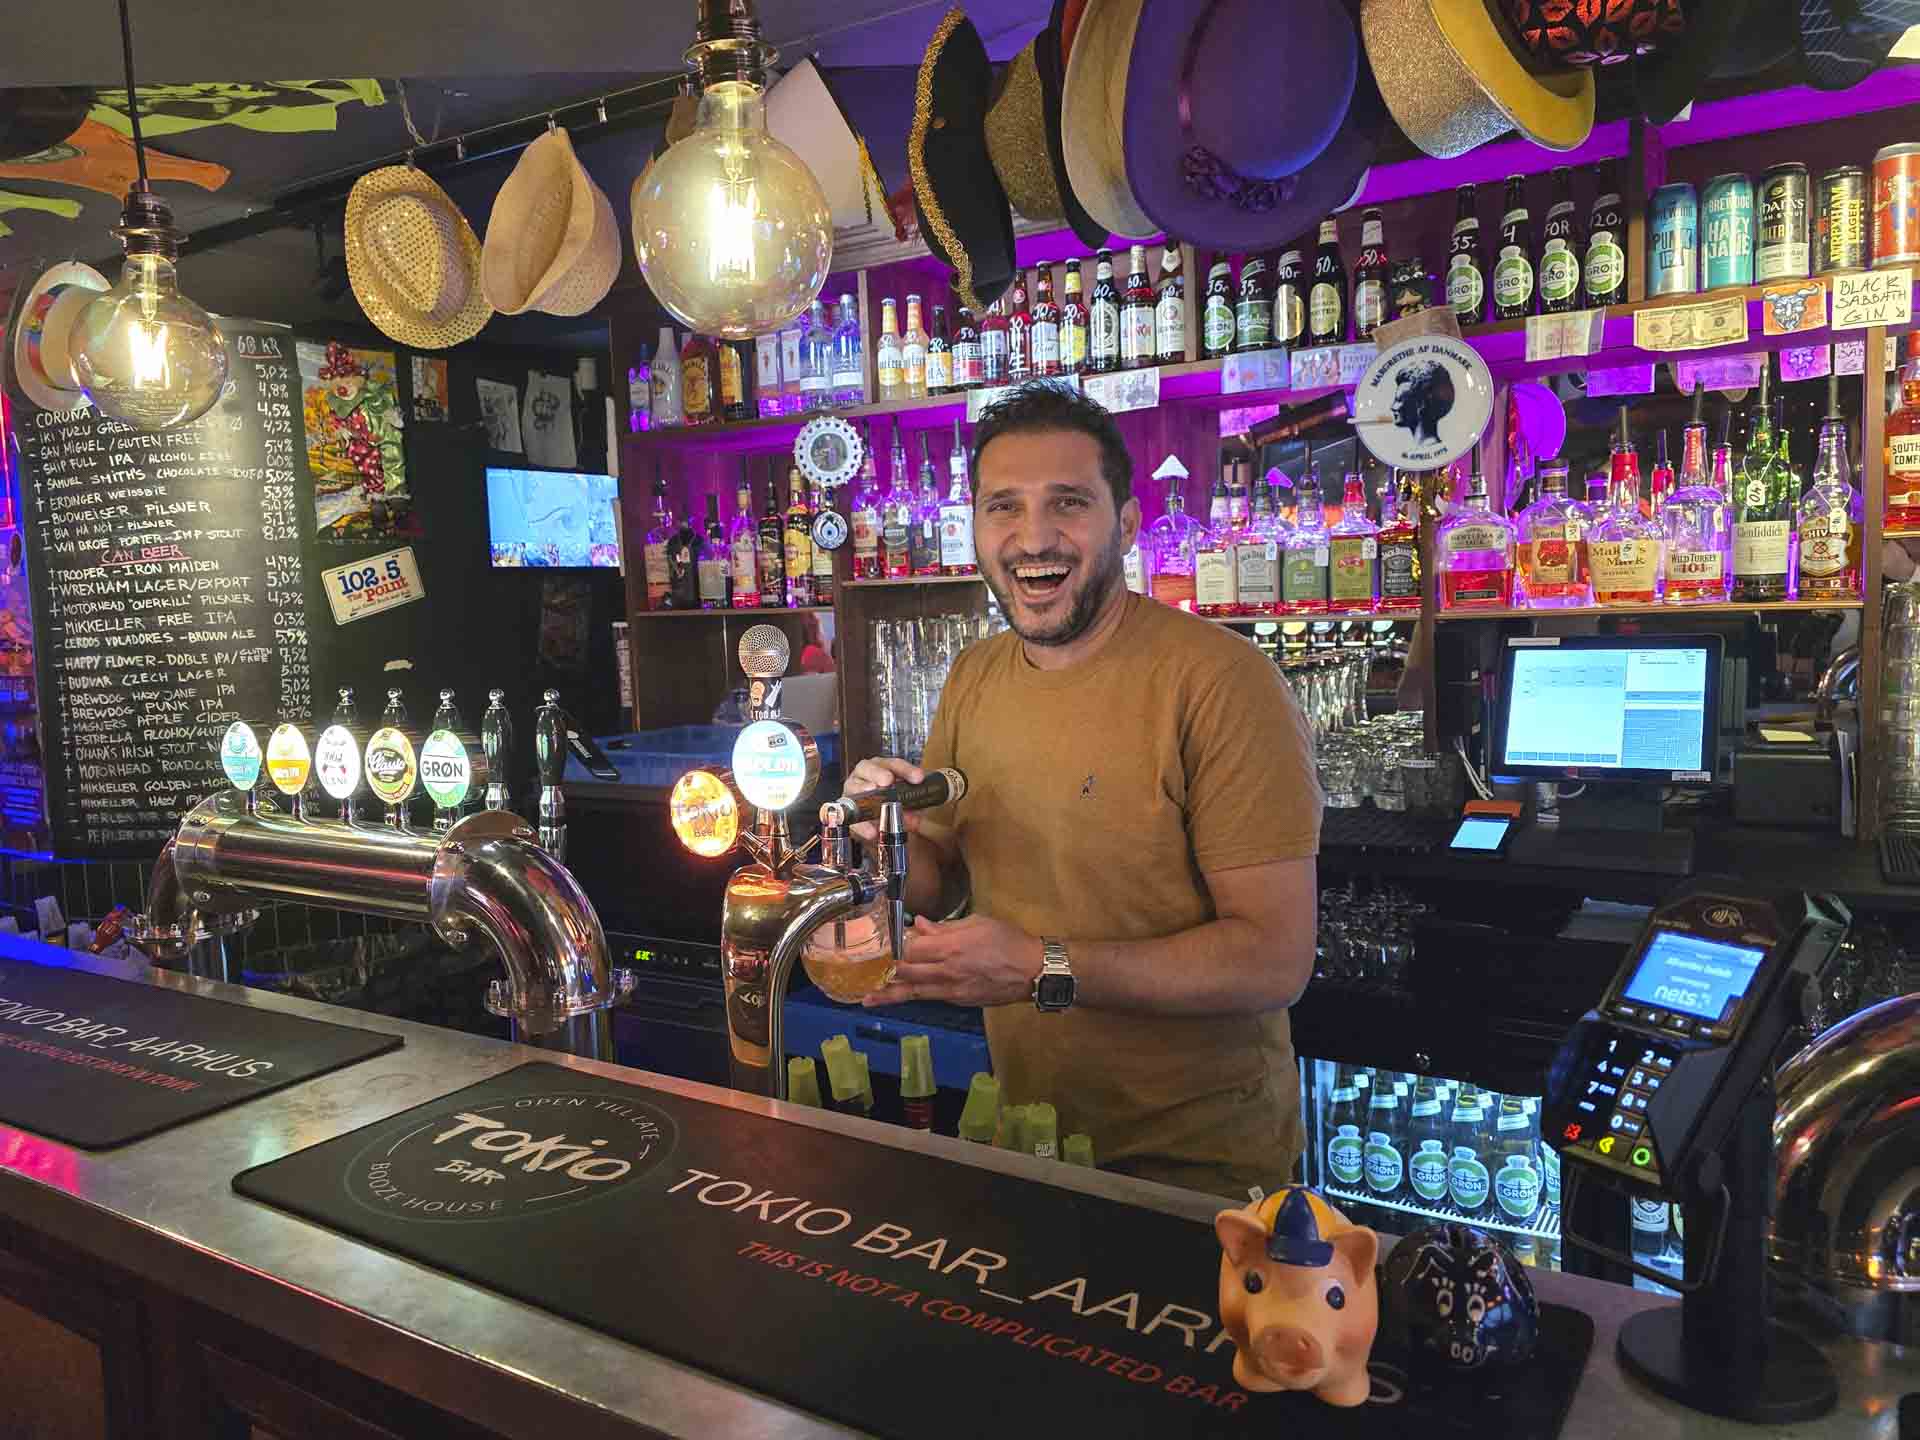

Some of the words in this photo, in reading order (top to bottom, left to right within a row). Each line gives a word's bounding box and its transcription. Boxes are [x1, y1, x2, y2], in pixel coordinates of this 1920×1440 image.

[1847, 200, 1859, 242] LAGER
[1503, 225, 1517, 242] 4
[1584, 261, 1621, 275] GRØN
[1495, 276, 1529, 291] GRØN
[1839, 274, 1900, 296] BLACK
[1835, 289, 1907, 309] SABBATH
[1843, 303, 1886, 323] GIN
[1431, 344, 1474, 371] DANMARK
[256, 400, 292, 418] 4,5%
[40, 445, 60, 460] SAN
[69, 456, 97, 470] FULL
[108, 453, 134, 467] IPA
[49, 492, 104, 511] ERDINGER
[1450, 531, 1494, 541] GENTLEMA
[1803, 527, 1844, 540] CHIVS
[100, 549, 135, 564] CAN
[140, 543, 185, 560] BEER
[56, 566, 109, 582] TROOPER
[168, 559, 220, 575] MAIDEN
[337, 559, 401, 595] 102.5
[58, 580, 131, 598] WREXHAM
[363, 575, 409, 602] point
[267, 590, 304, 607] 4,3%
[157, 611, 194, 627] FREE
[64, 653, 101, 670] HAPPY
[121, 671, 170, 687] CZECH
[177, 667, 227, 683] LAGER
[69, 692, 126, 707] BREWDOG
[216, 683, 237, 697] IPA
[71, 706, 135, 720] BREWDOG
[144, 700, 191, 714] PUNK
[199, 697, 225, 712] IPA
[136, 713, 185, 728] APPLE
[195, 711, 242, 724] CIDER
[75, 730, 134, 745] ESTRELLA
[121, 743, 154, 759] IRISH
[159, 741, 199, 756] STOUT
[421, 760, 464, 778] GRØN
[143, 779, 192, 793] GOLDEN
[1654, 984, 1698, 1007] nets
[0, 998, 66, 1026] OKIO
[1641, 1050, 1655, 1064] 2
[1586, 1080, 1600, 1094] 7
[1631, 1071, 1645, 1085] 5
[513, 1096, 588, 1110] OPEN
[593, 1099, 634, 1121] TILL
[630, 1113, 662, 1146] LATE
[1610, 1114, 1624, 1129] 0
[431, 1110, 632, 1182] TOKIO
[367, 1159, 397, 1202] BOOZE
[432, 1156, 507, 1186] BAR
[398, 1196, 506, 1216] HOUSE
[665, 1167, 853, 1237] TOKIO
[736, 1240, 804, 1271] THIS
[797, 1261, 834, 1279] IS
[825, 1267, 902, 1299] NOT
[894, 1290, 921, 1310] A
[920, 1298, 1176, 1385] COMPLICATED
[1164, 1374, 1250, 1413] BAR
